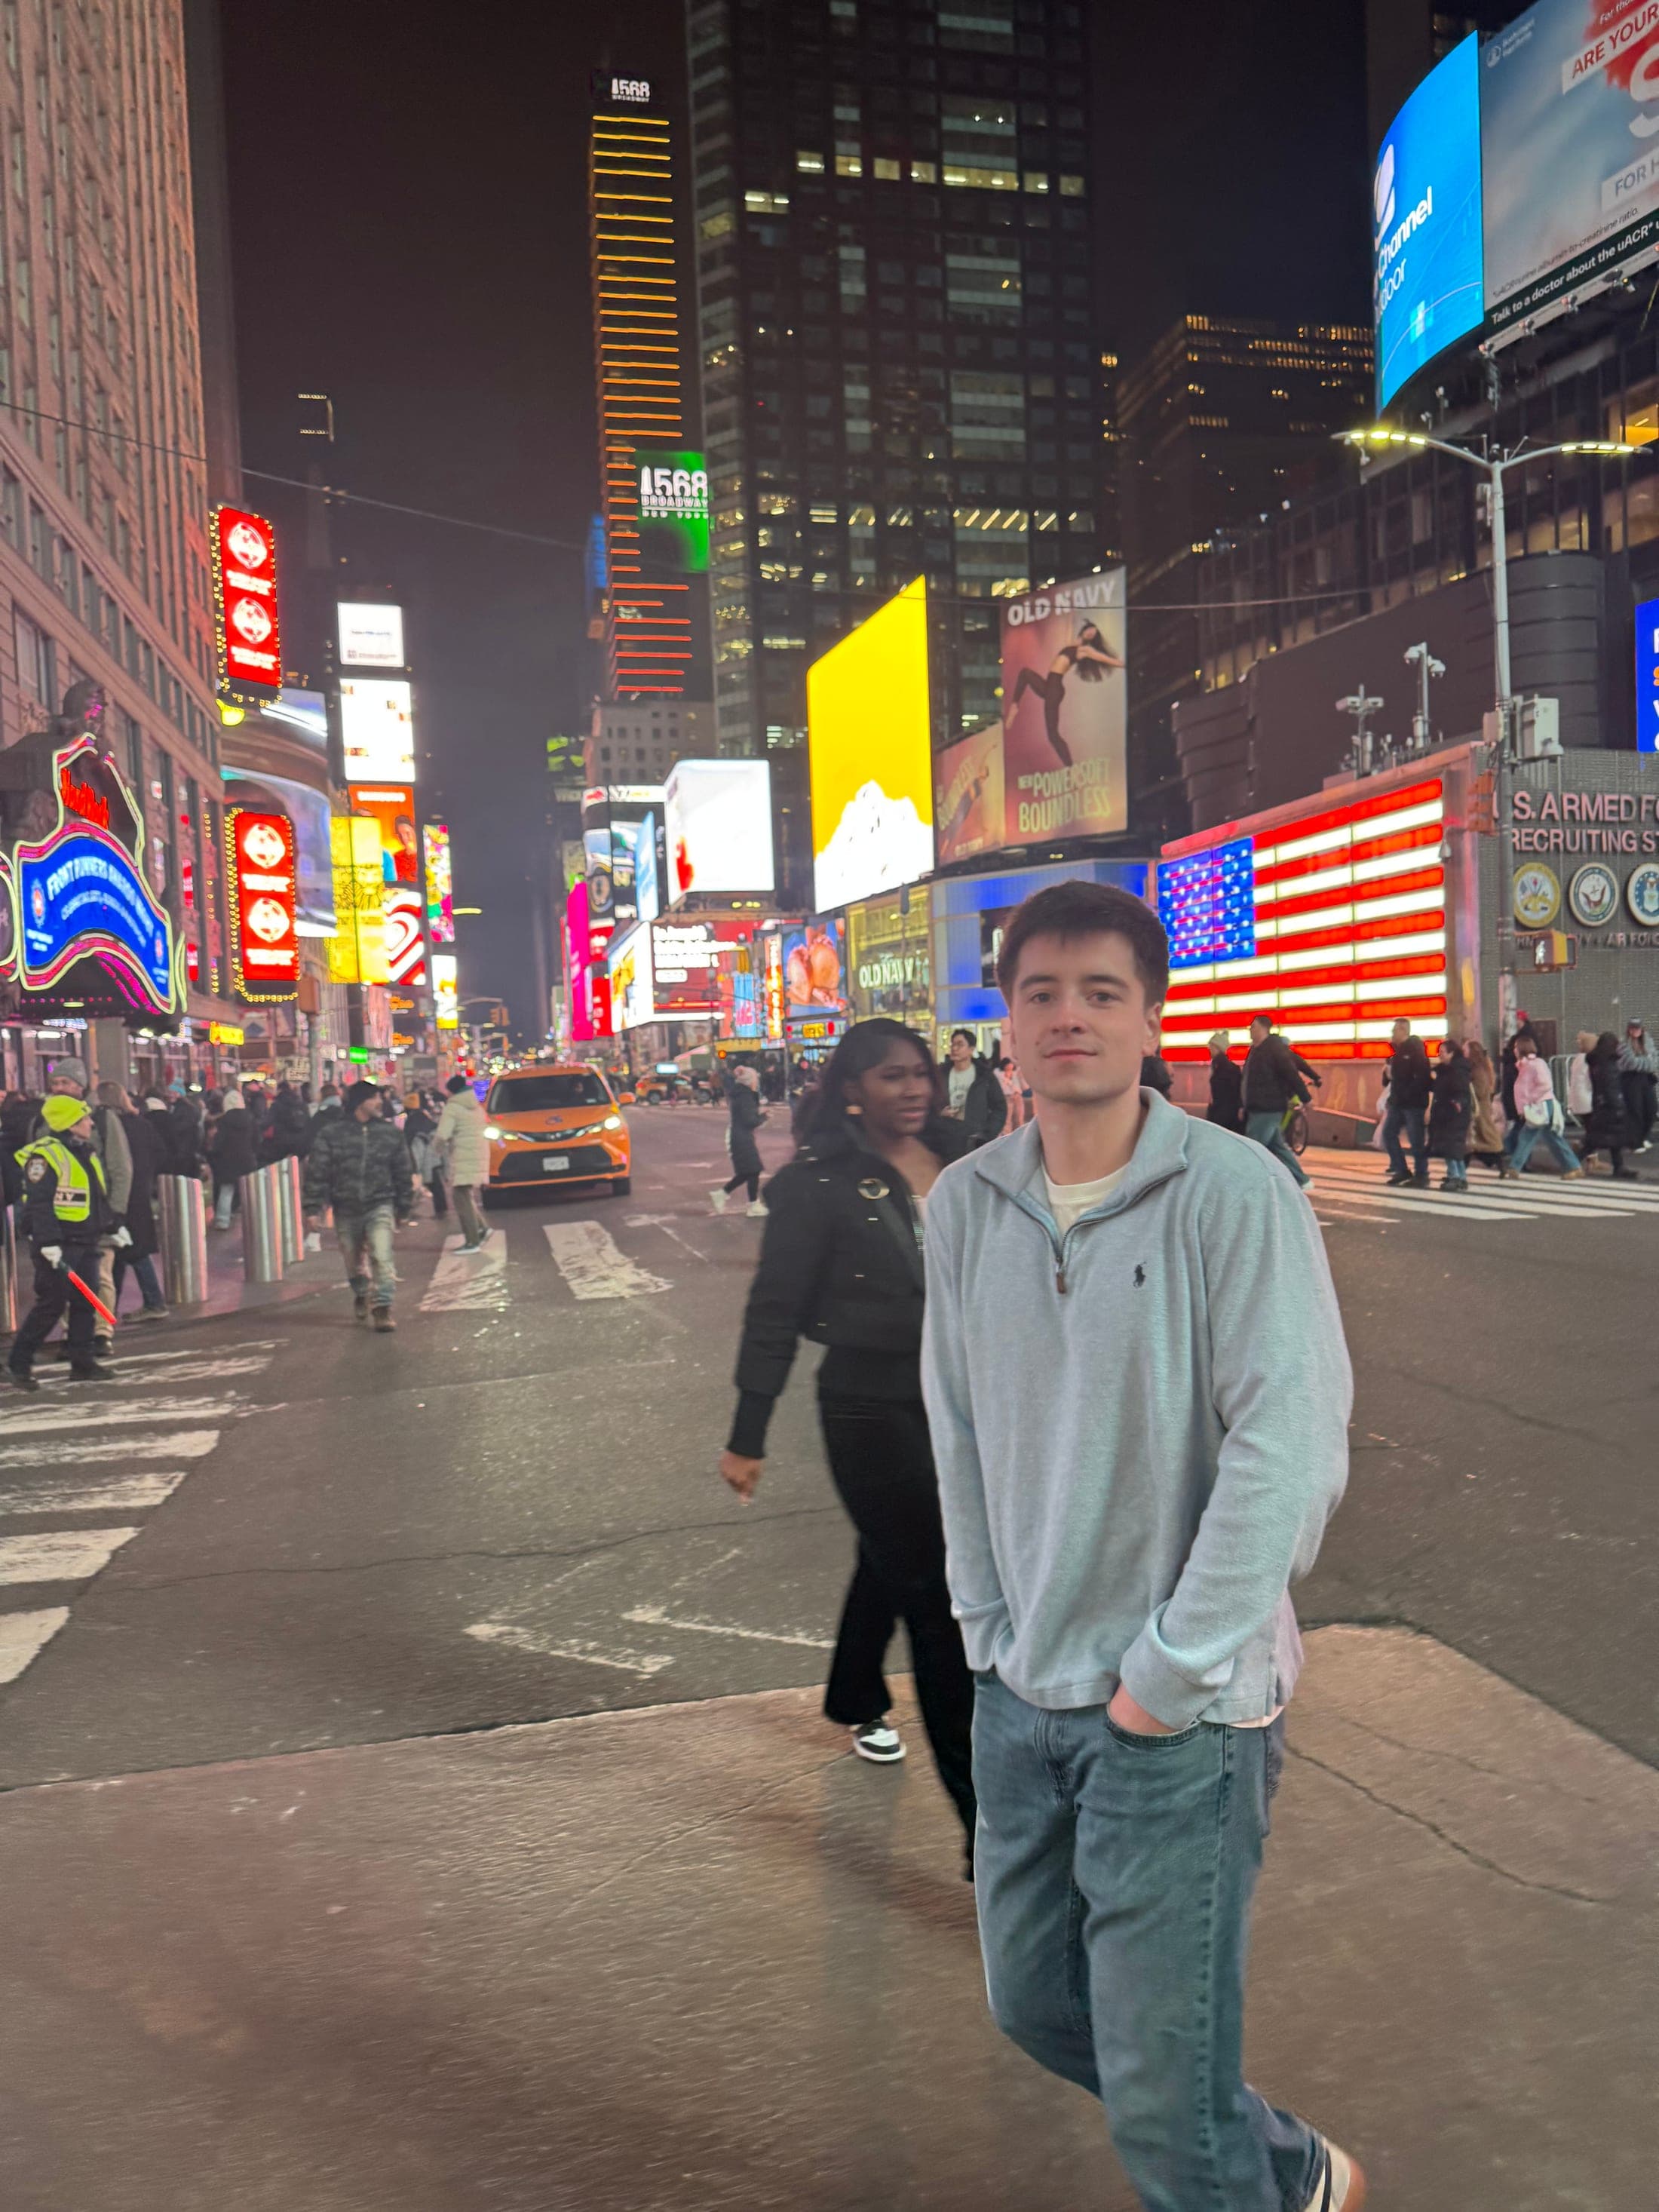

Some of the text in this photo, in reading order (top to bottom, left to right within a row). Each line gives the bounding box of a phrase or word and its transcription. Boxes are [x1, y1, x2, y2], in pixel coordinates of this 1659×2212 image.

[1572, 41, 1606, 79] ARE
[1608, 2, 1659, 50] YOUR
[1615, 161, 1647, 198] FOR
[1491, 305, 1511, 325] Talk
[1512, 301, 1523, 313] to
[1524, 296, 1531, 305] a
[1532, 275, 1565, 302] doctor
[1566, 256, 1596, 281] about
[1598, 247, 1616, 263] the
[640, 465, 708, 498] 1568
[1007, 580, 1117, 627] OLD NAVY
[1019, 785, 1112, 833] BOUNDLESS
[1541, 792, 1636, 821] ARMED
[1641, 795, 1659, 821] F
[1511, 828, 1637, 853] RECRUITING
[859, 957, 914, 989] OLD NAVY
